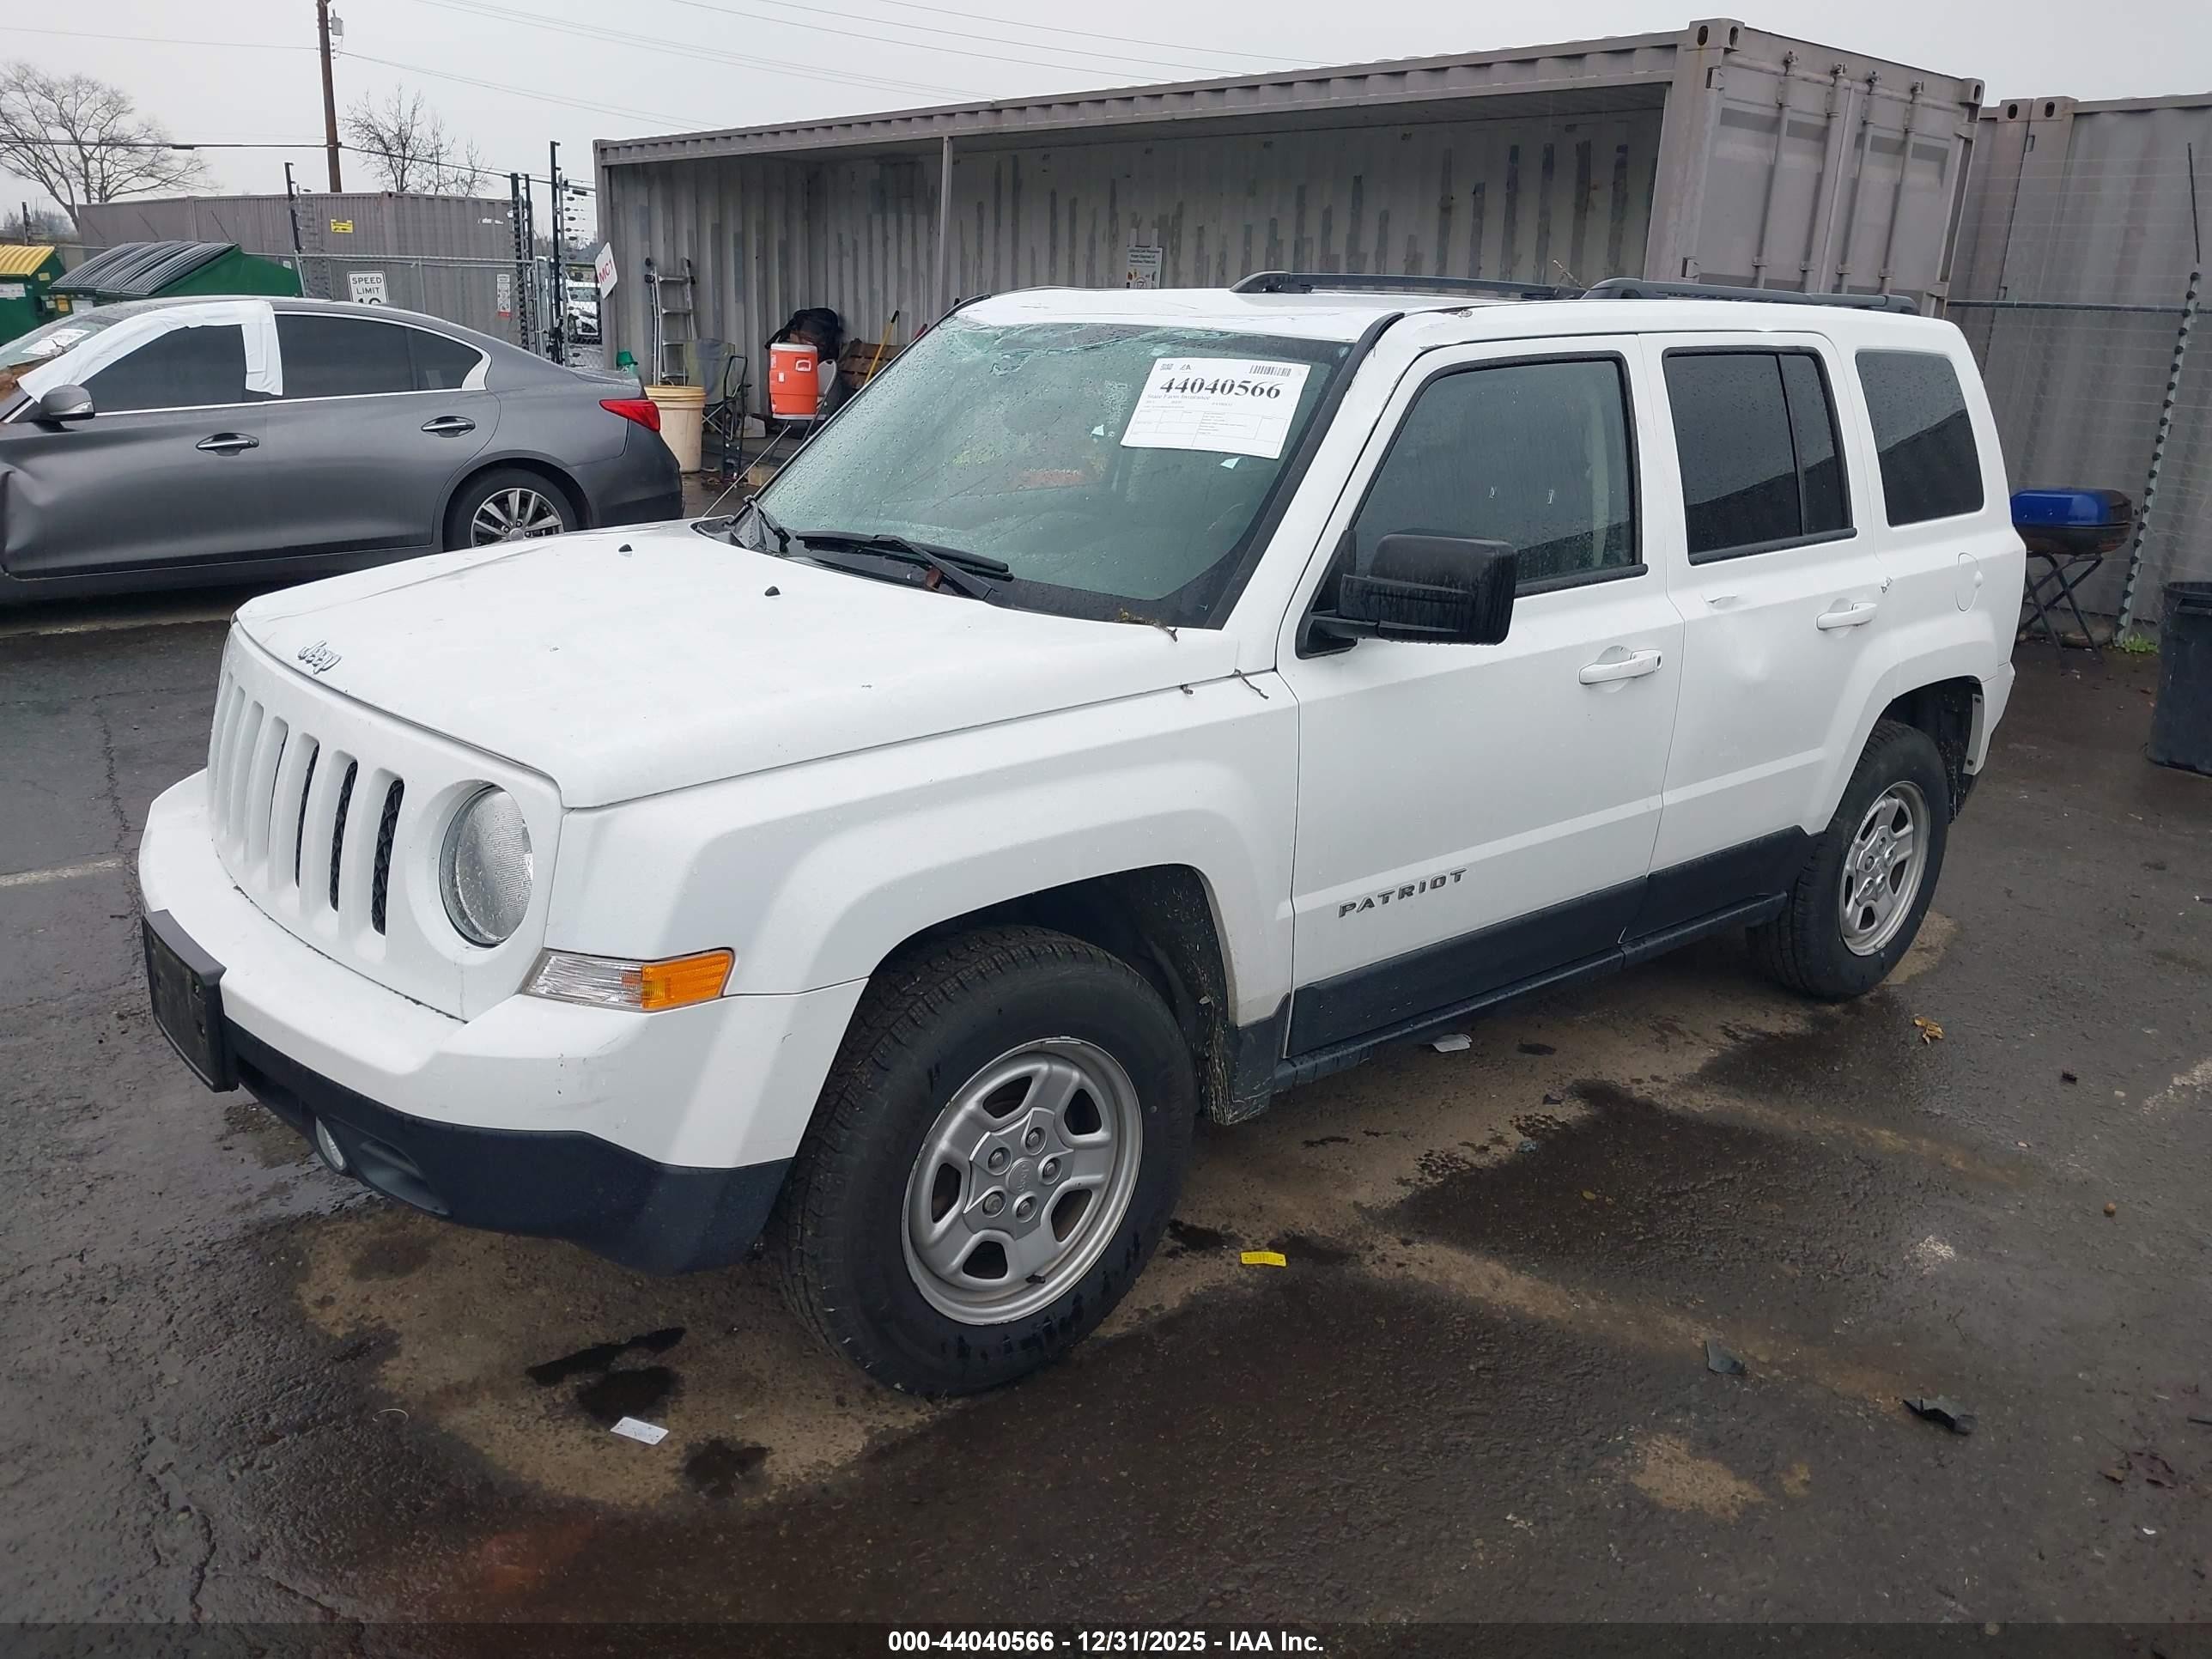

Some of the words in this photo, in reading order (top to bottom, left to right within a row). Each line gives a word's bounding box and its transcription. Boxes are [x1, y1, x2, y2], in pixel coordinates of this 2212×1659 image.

[1160, 377, 1285, 398] 44040566
[297, 640, 342, 675] Jeep
[1339, 867, 1468, 918] PATRIOT
